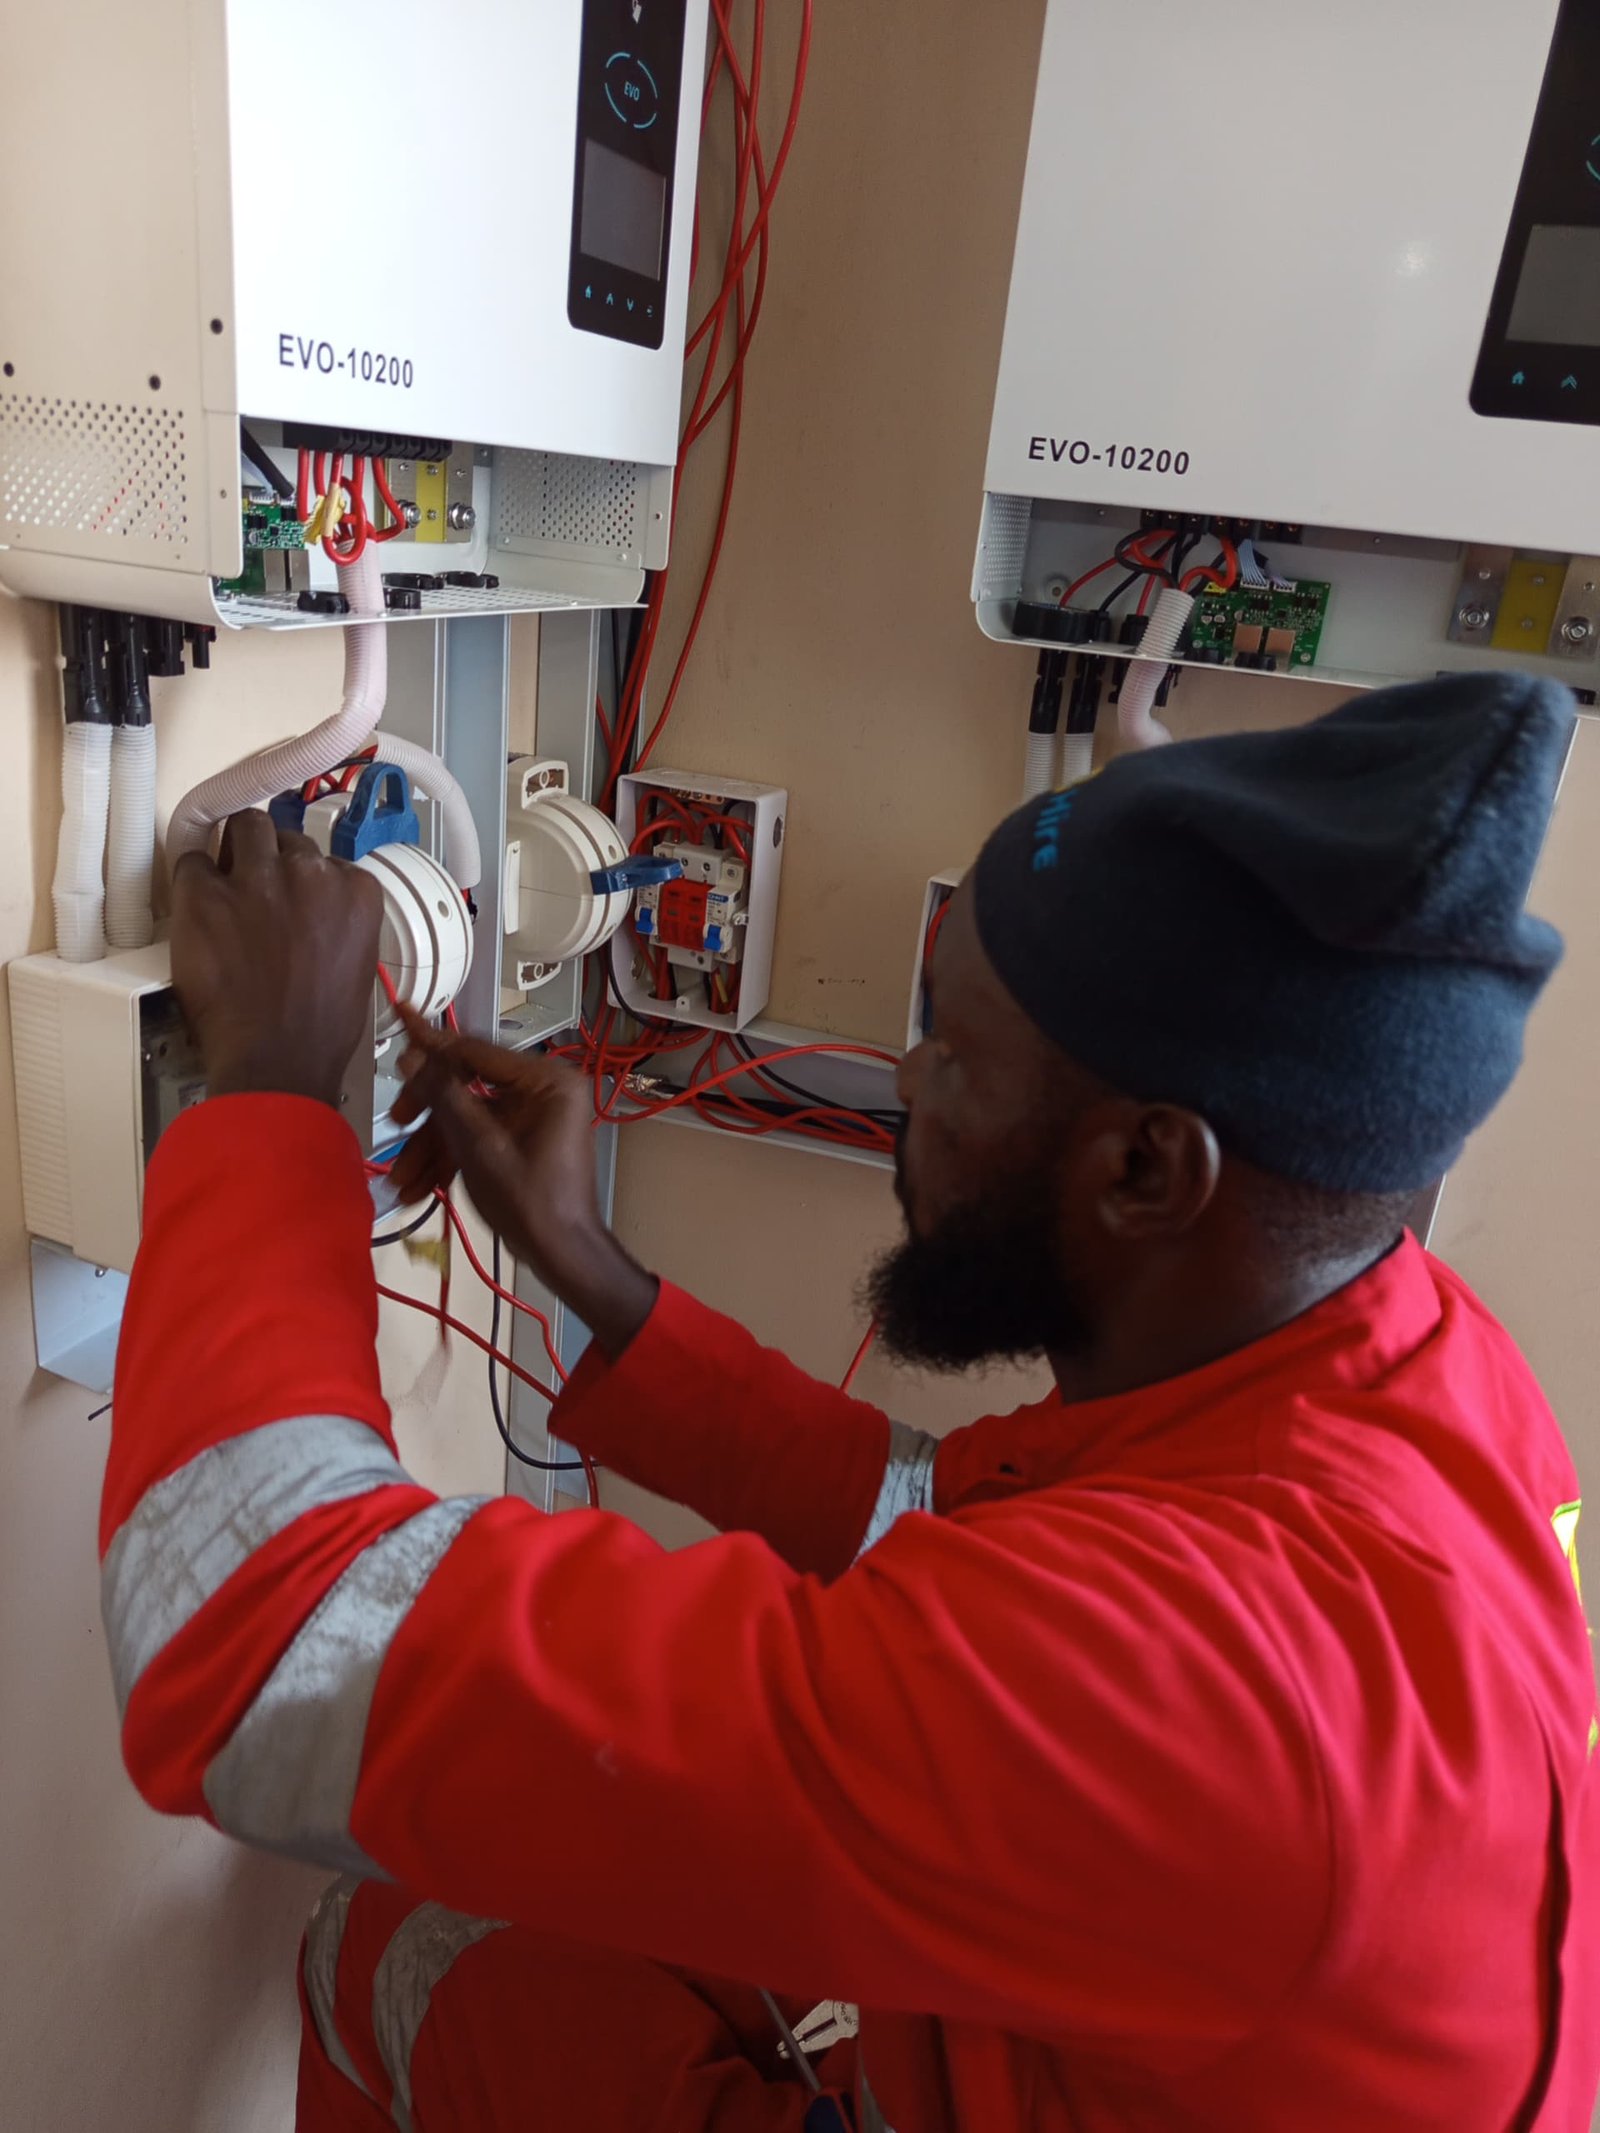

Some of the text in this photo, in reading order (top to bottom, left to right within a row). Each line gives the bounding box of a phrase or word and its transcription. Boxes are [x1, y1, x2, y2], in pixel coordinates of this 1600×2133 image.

[624, 81, 641, 102] EVO
[279, 332, 414, 389] EVO-10200
[1028, 436, 1190, 475] EVO-10200
